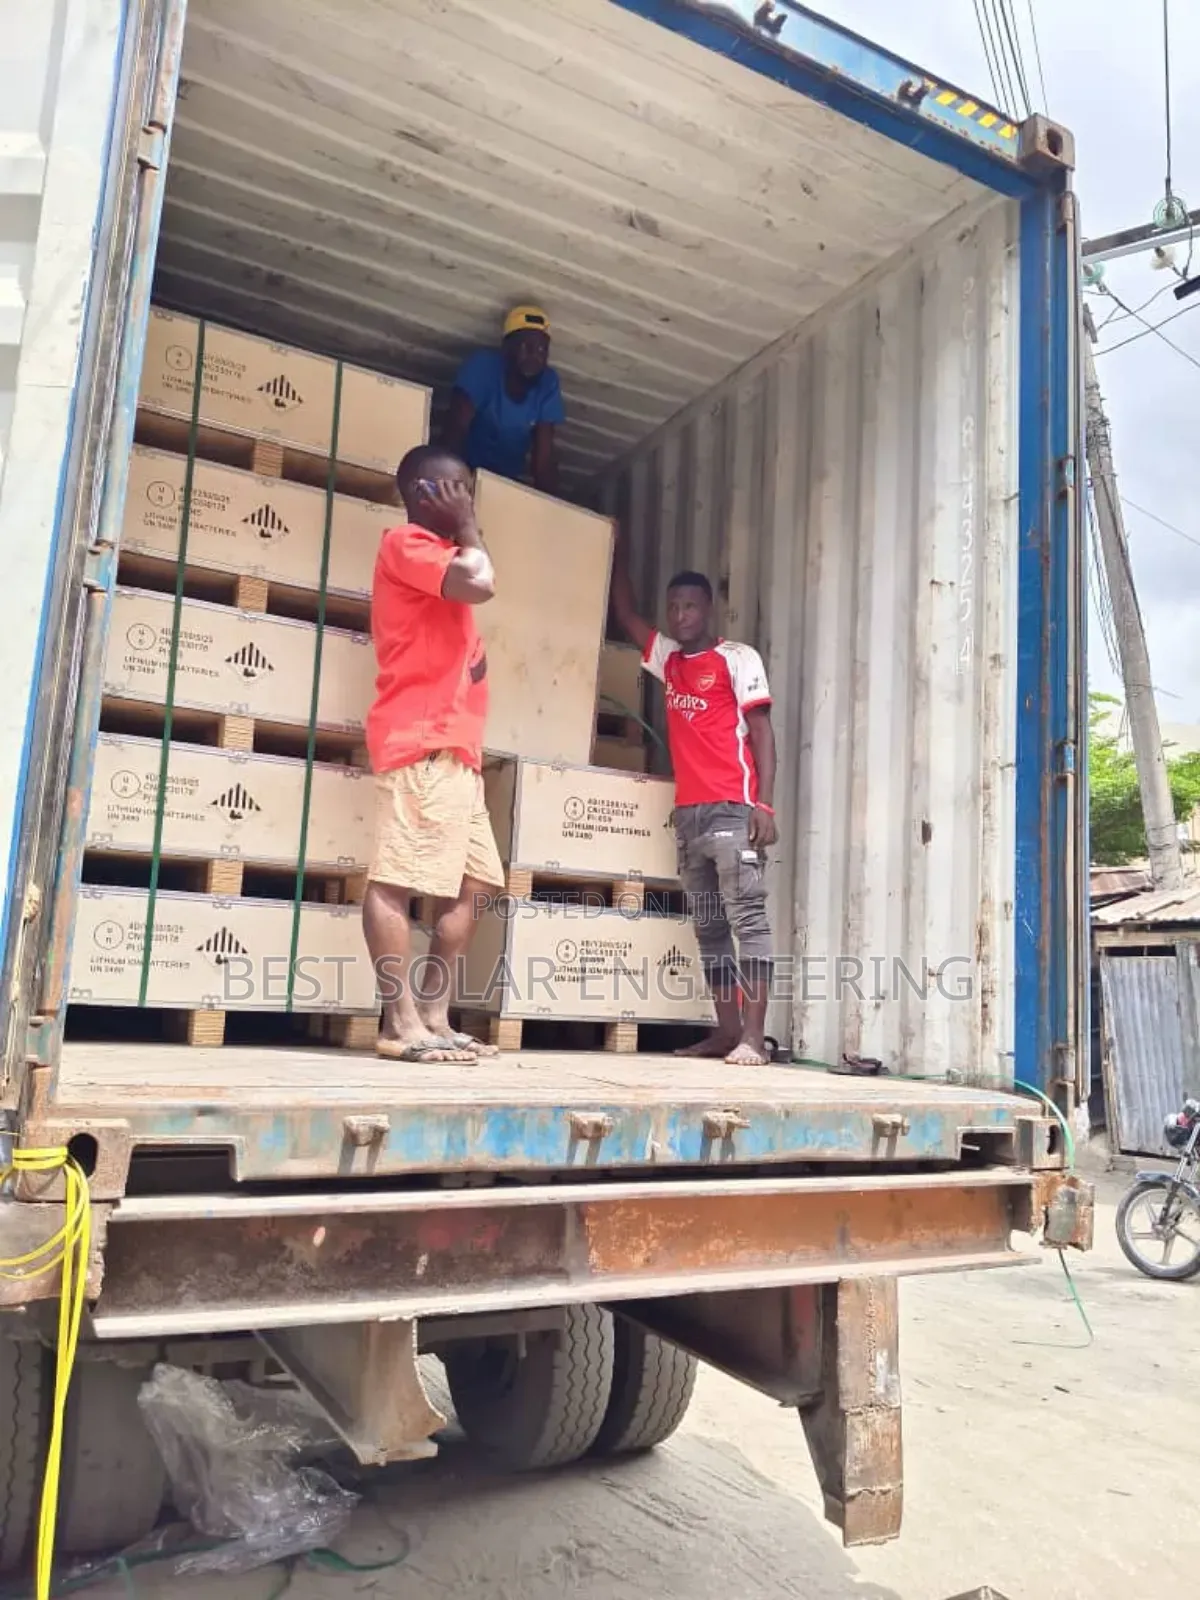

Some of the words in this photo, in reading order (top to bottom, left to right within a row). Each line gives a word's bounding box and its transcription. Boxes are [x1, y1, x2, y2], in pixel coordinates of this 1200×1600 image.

[107, 804, 142, 814] LITHIUM
[562, 822, 595, 832] LITHIUM
[610, 826, 651, 837] BATTERIES
[90, 956, 126, 966] LITHIUM
